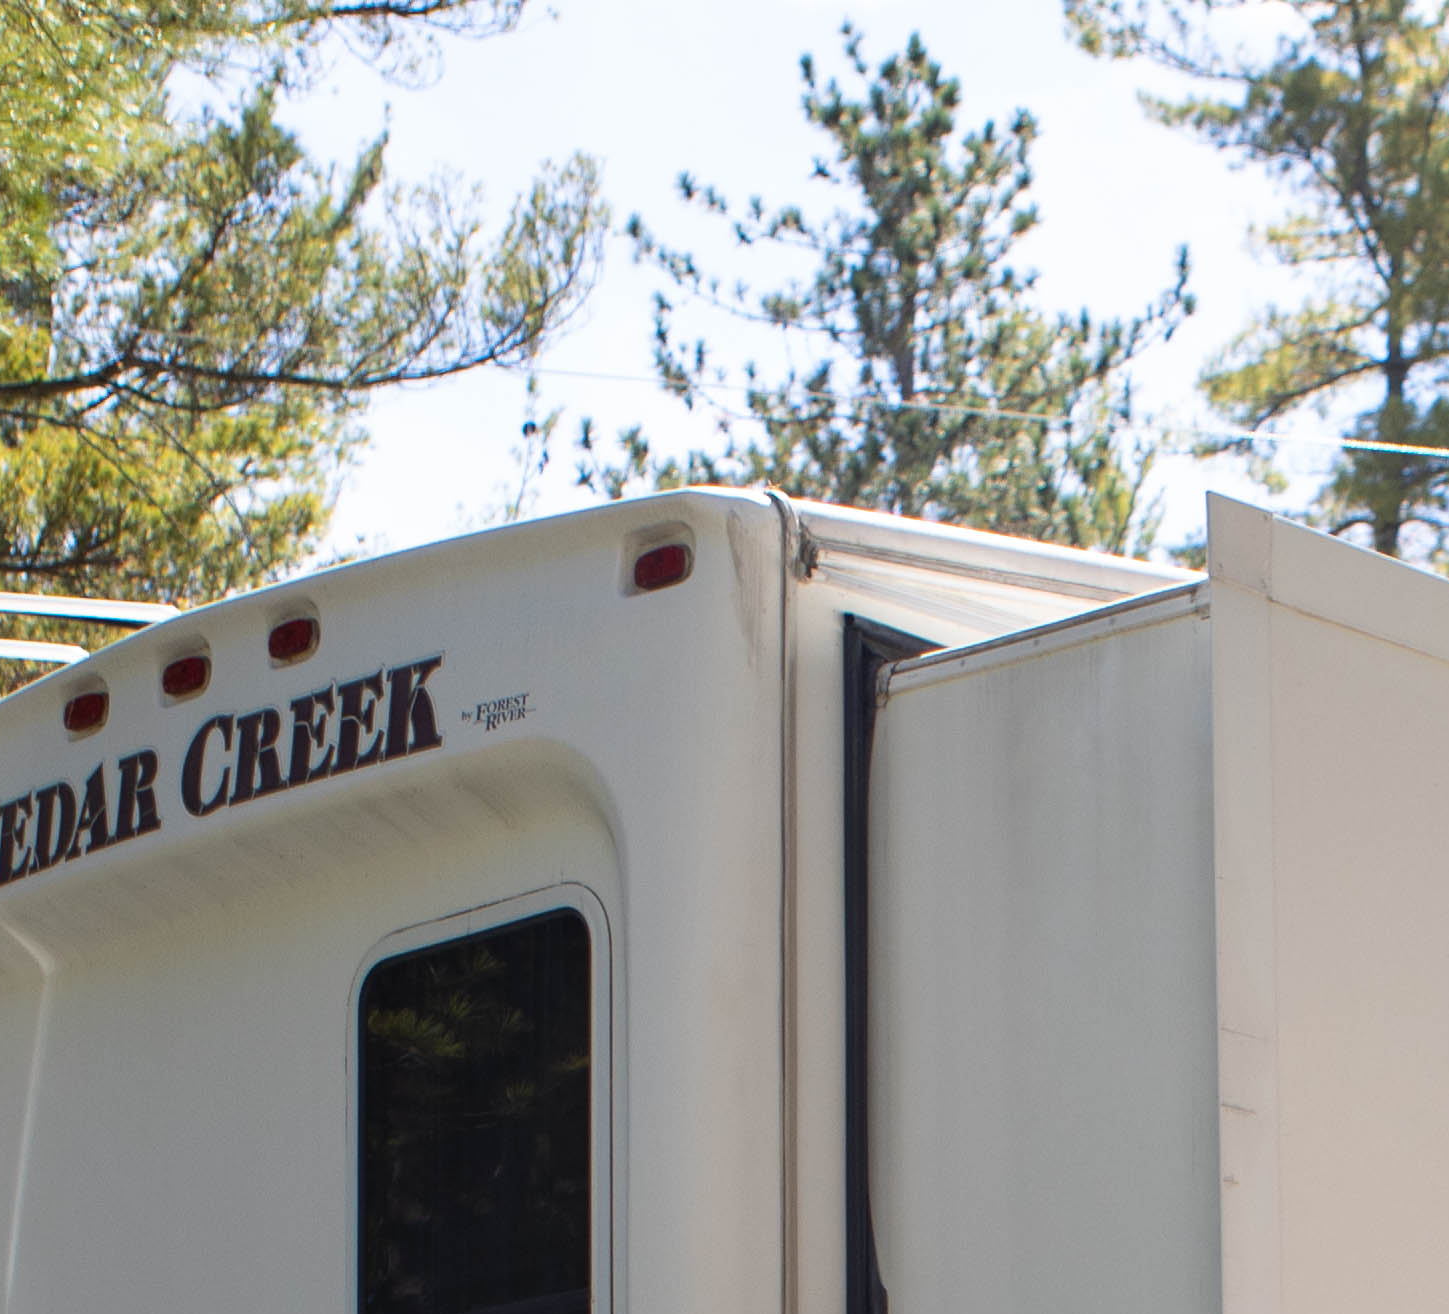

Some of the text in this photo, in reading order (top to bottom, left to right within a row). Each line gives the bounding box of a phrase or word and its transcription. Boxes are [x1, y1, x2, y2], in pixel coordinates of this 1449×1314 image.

[474, 692, 529, 725] FOREST
[485, 707, 527, 732] RIVER
[180, 653, 445, 819] CREEK
